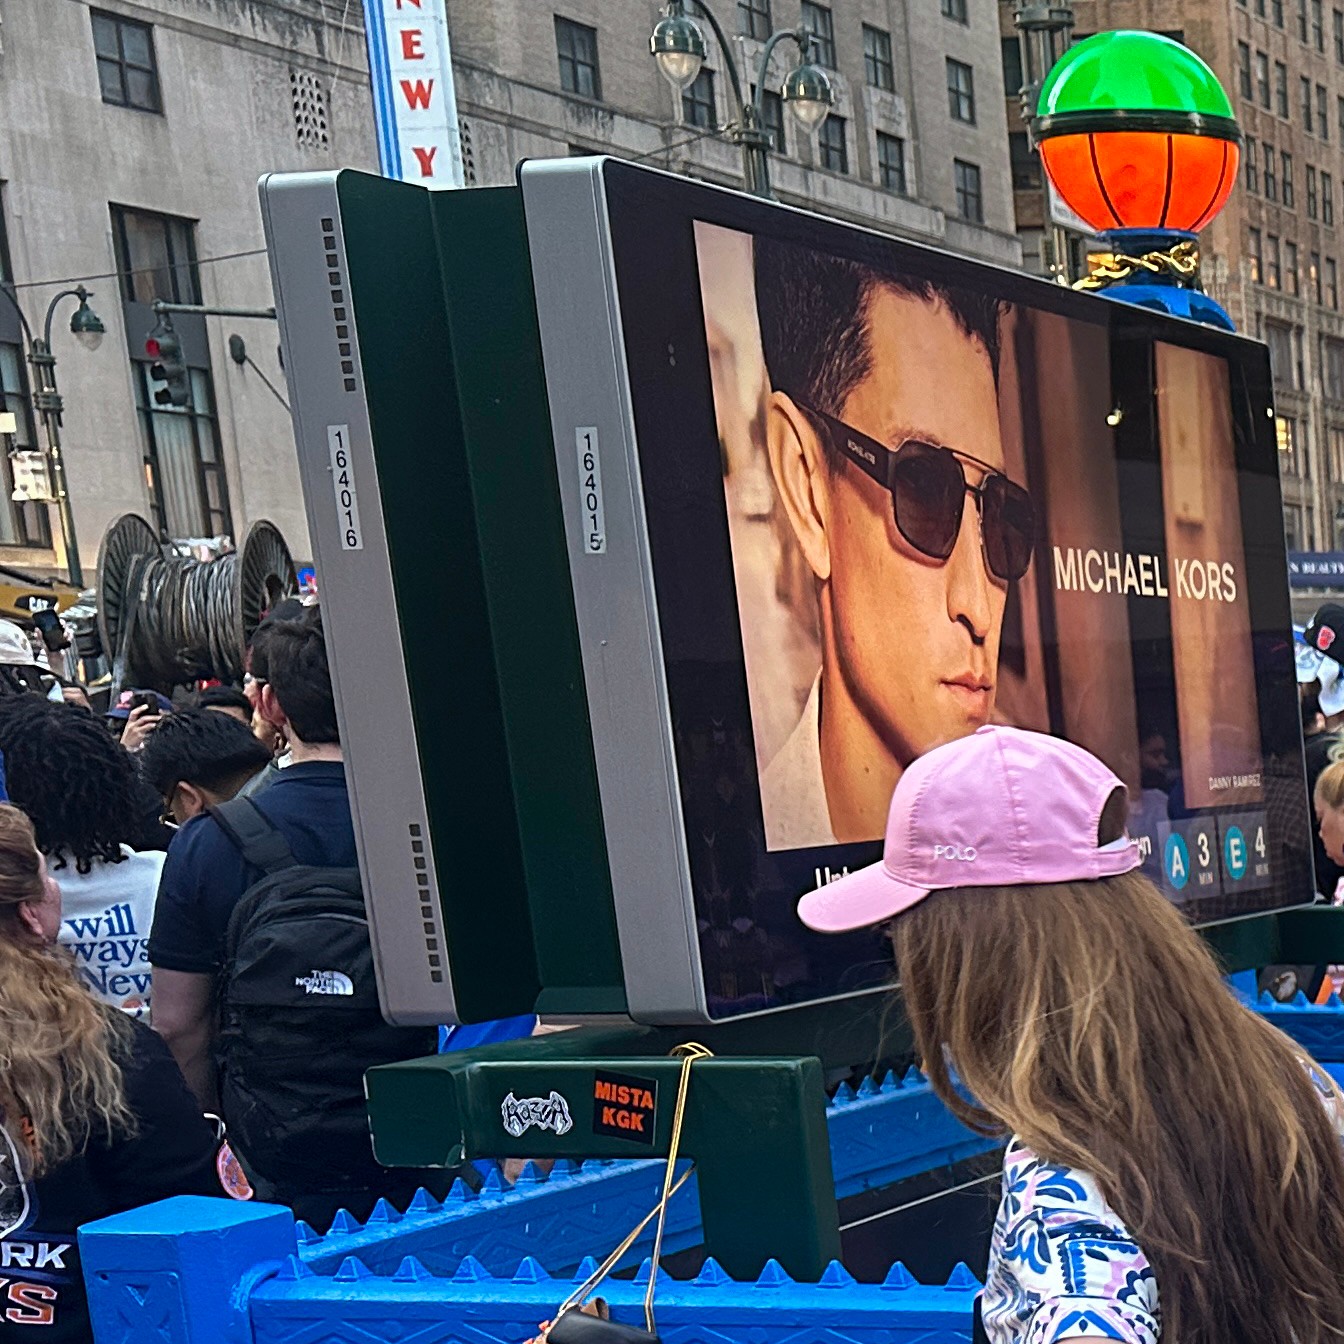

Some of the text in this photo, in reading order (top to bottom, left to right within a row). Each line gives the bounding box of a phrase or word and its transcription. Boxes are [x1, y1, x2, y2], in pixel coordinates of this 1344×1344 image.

[334, 430, 357, 548] 164016
[583, 433, 604, 551] 164015
[1053, 545, 1237, 603] MICHAEL KORS
[934, 844, 978, 862] POLO
[1171, 845, 1186, 879] A
[1197, 832, 1211, 868] 3
[1229, 825, 1267, 869] E 4
[64, 903, 138, 939] will
[295, 976, 331, 987] NORTH
[305, 985, 332, 995] FACE
[594, 1080, 654, 1110] MISTA
[602, 1106, 645, 1133] KGK
